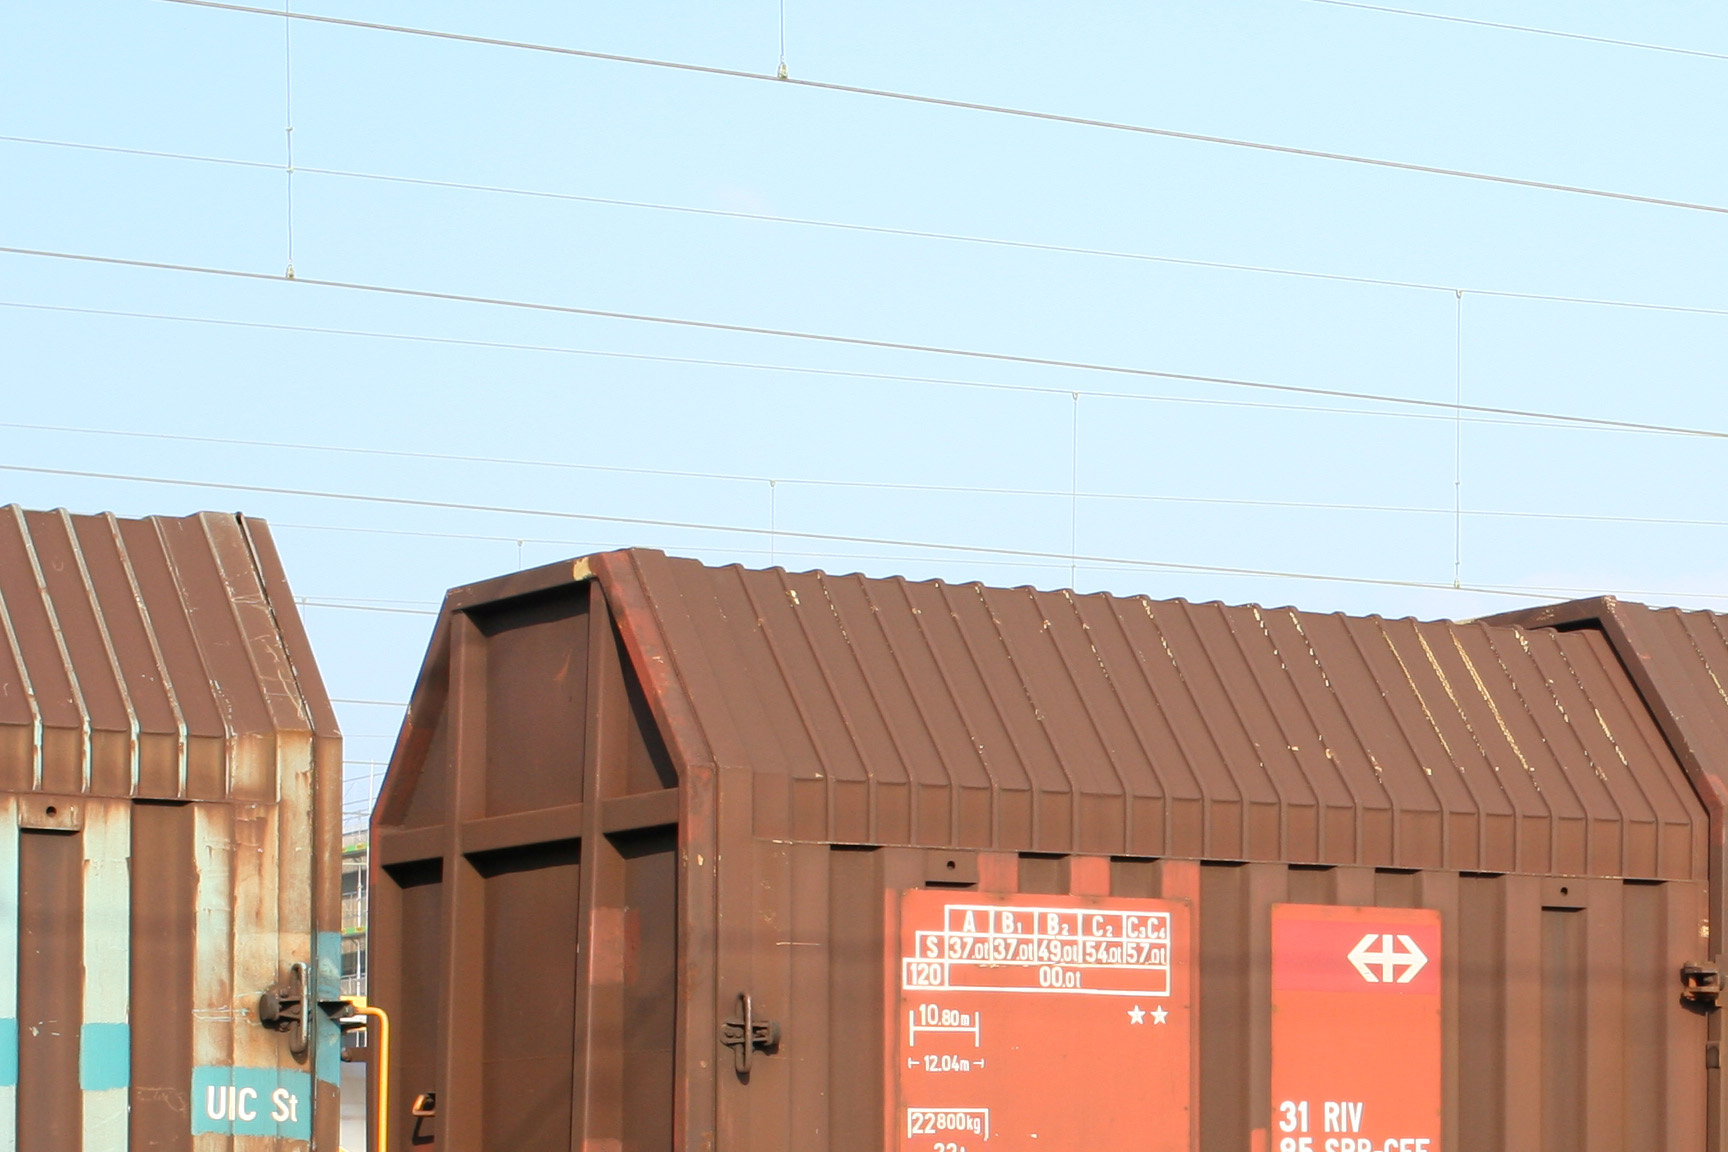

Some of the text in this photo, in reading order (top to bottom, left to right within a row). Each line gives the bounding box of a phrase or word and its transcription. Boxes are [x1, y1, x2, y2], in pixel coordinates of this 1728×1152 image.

[963, 910, 975, 933] A
[927, 936, 938, 958] S
[910, 963, 941, 985] 120
[919, 1004, 970, 1026] 10.80m
[924, 1055, 970, 1072] 12.04m
[206, 1086, 298, 1123] UIC St
[1279, 1101, 1364, 1133] 31 RIV
